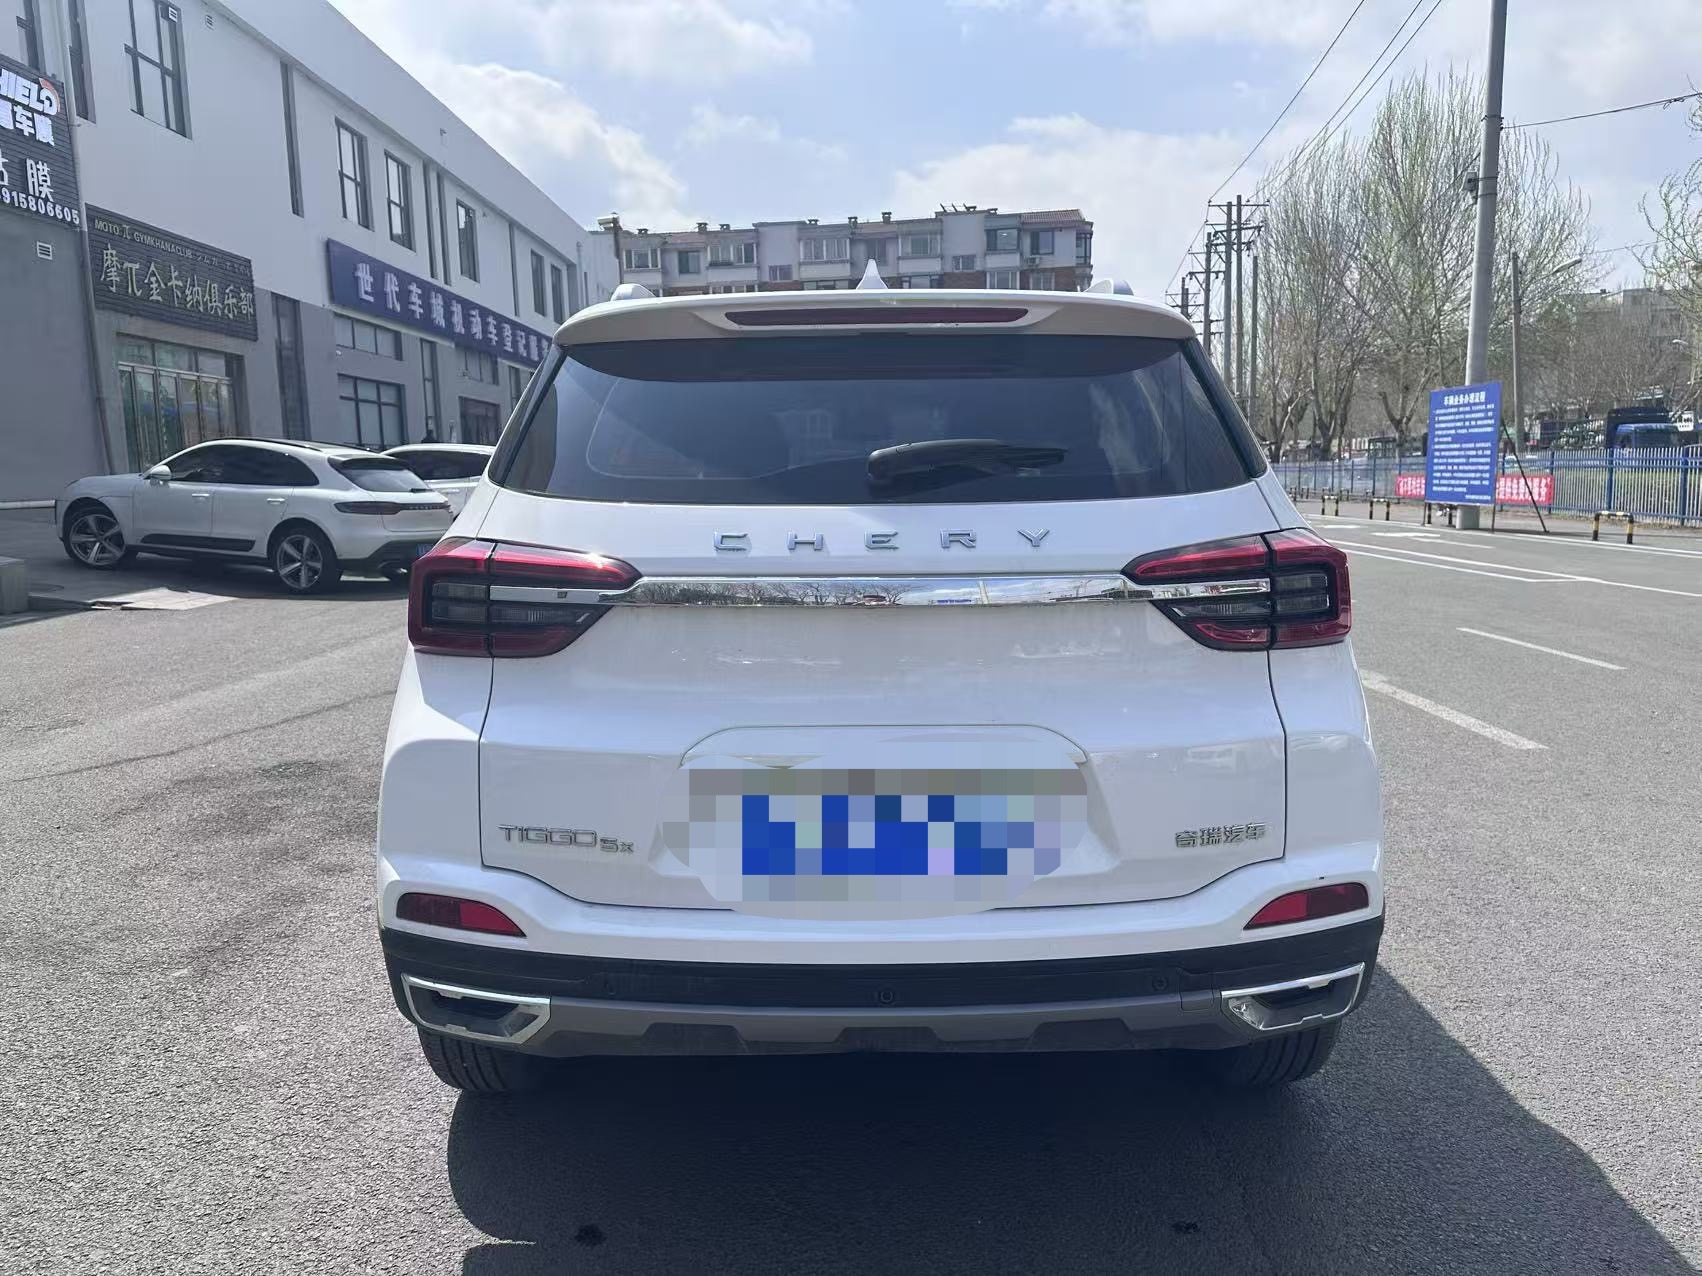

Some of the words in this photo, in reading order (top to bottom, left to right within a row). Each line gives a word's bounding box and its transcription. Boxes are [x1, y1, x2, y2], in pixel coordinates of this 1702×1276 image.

[0, 187, 79, 224] 915806605
[713, 528, 1050, 551] CHERY
[498, 824, 598, 848] TIGGO
[1175, 822, 1267, 848] 奇瑞汽车
